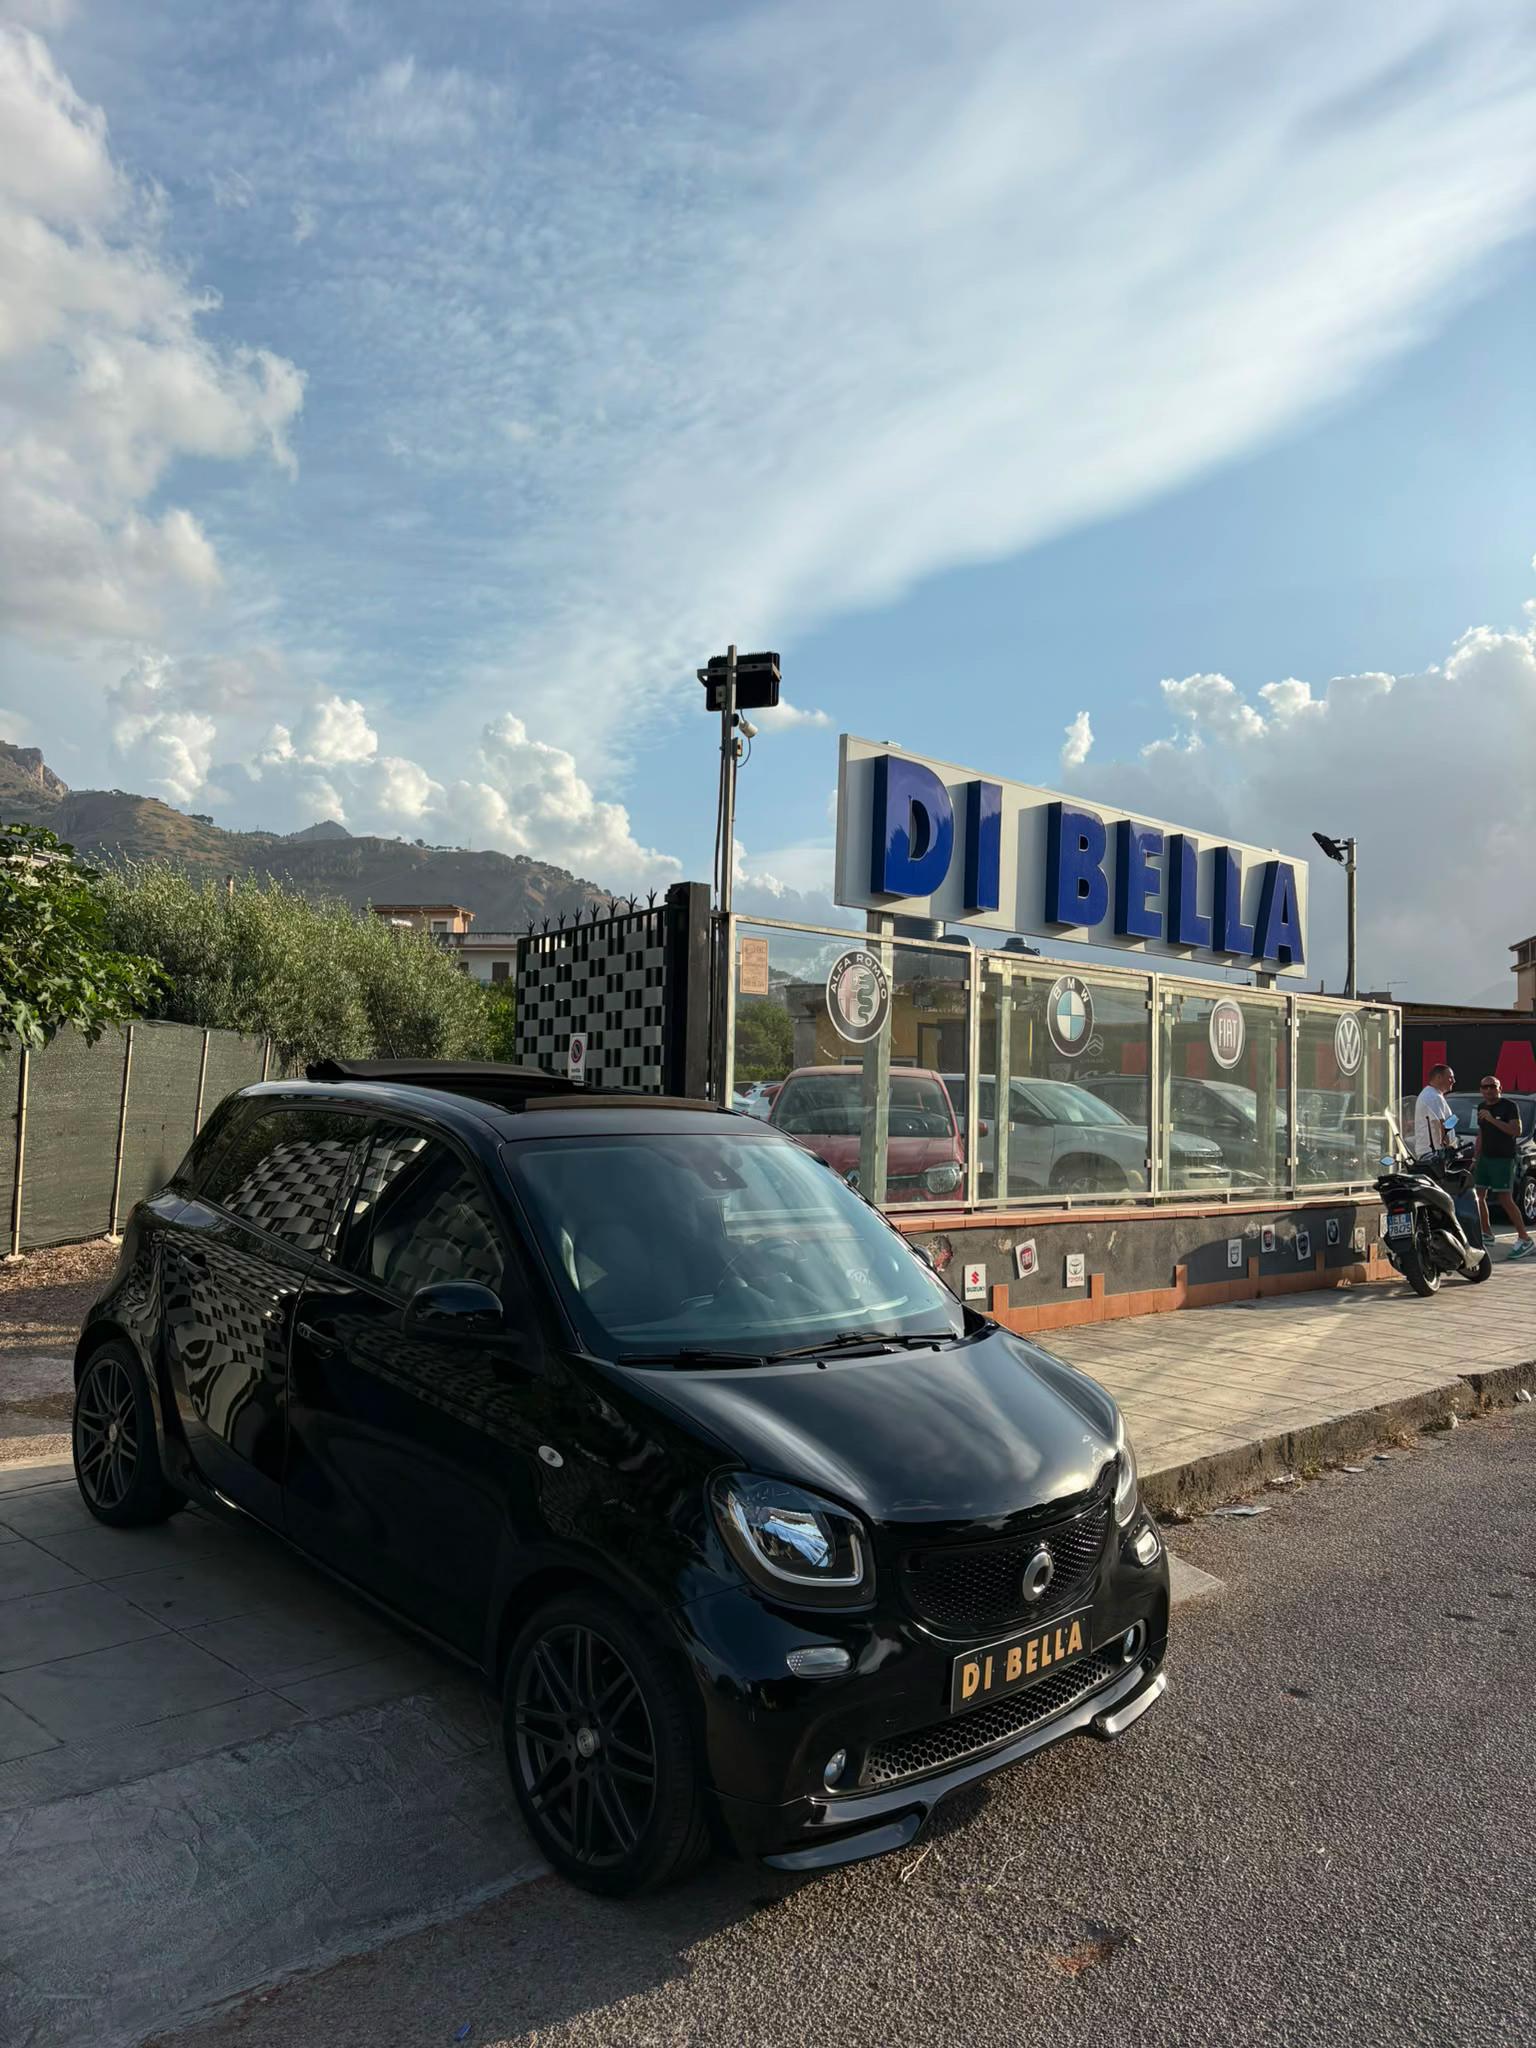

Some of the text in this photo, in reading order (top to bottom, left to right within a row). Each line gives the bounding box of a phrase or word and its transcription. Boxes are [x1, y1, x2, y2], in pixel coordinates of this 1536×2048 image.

[870, 754, 1305, 965] DI BELLA
[830, 954, 887, 999] ALFA ROMEO
[1053, 977, 1090, 1003] BMW
[1218, 1017, 1238, 1049] FIAT
[962, 1620, 1083, 1700] DI BELLA
